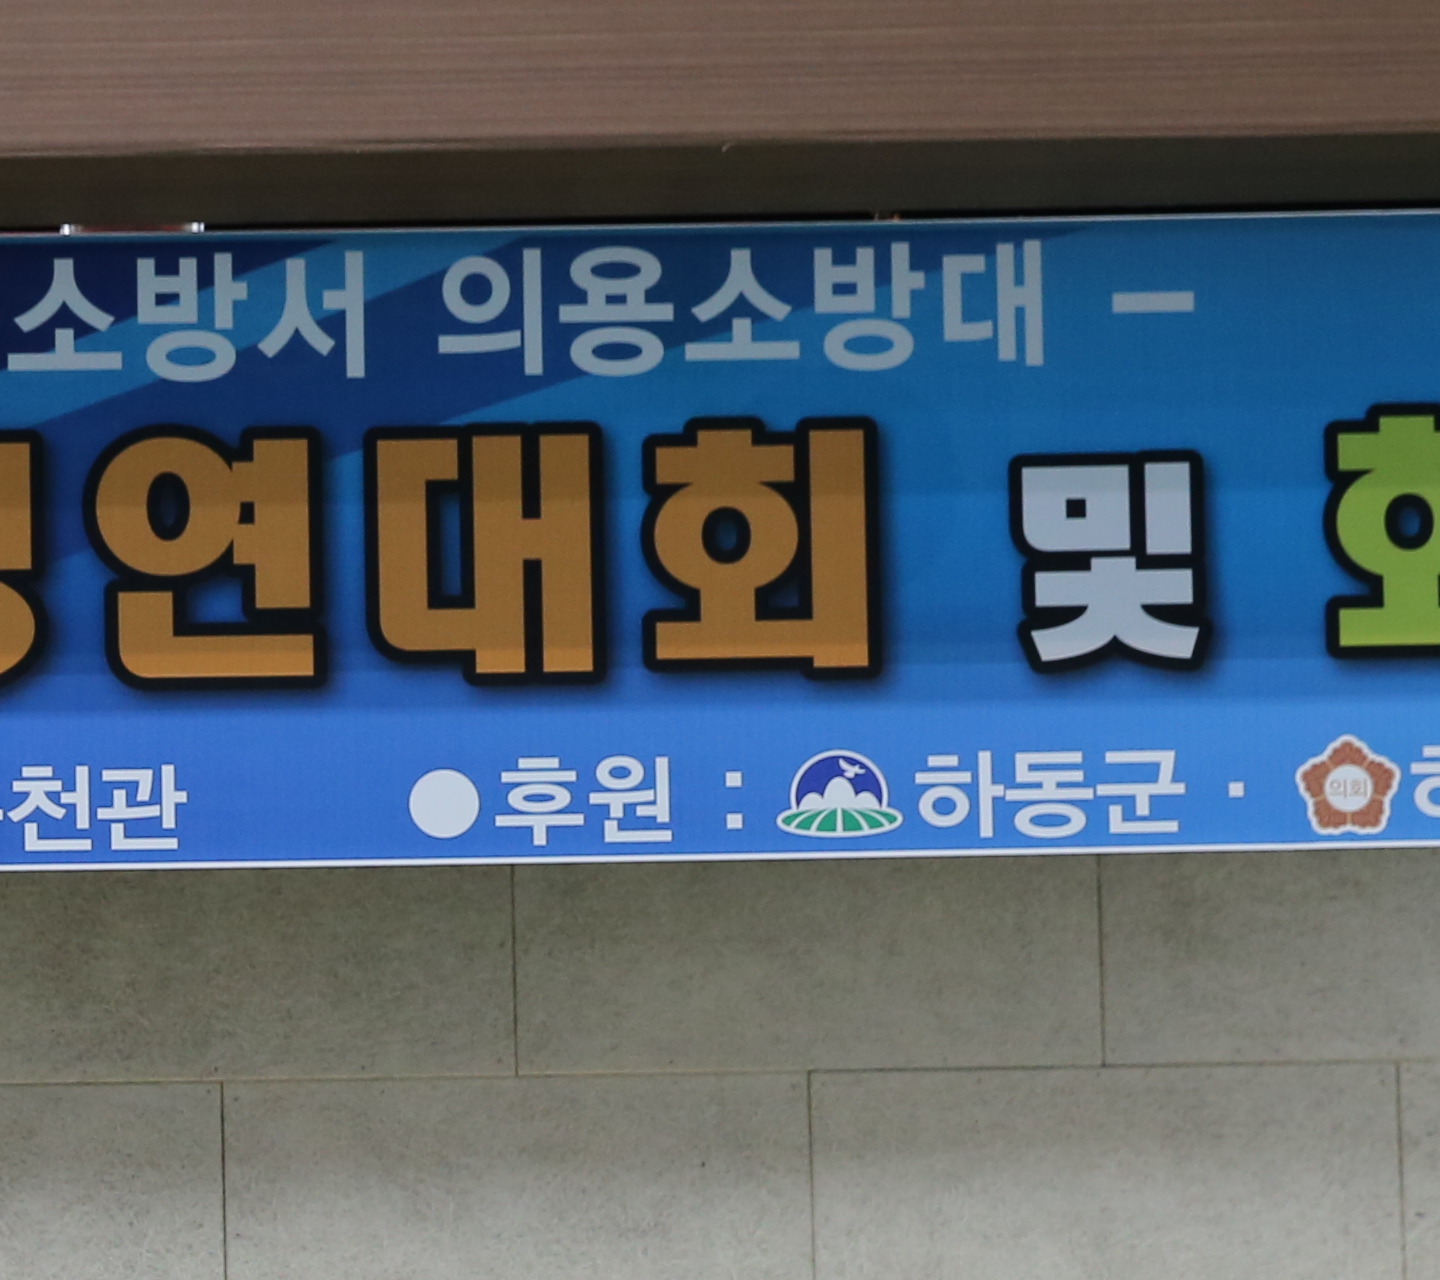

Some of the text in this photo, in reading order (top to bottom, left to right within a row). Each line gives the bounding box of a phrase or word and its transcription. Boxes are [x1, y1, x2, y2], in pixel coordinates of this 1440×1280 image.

[439, 240, 1044, 378] 의용소방대
[1010, 450, 1213, 672] 및
[493, 753, 672, 845] 후원
[916, 750, 1185, 838] 하동군
[1328, 776, 1374, 798] 의회
